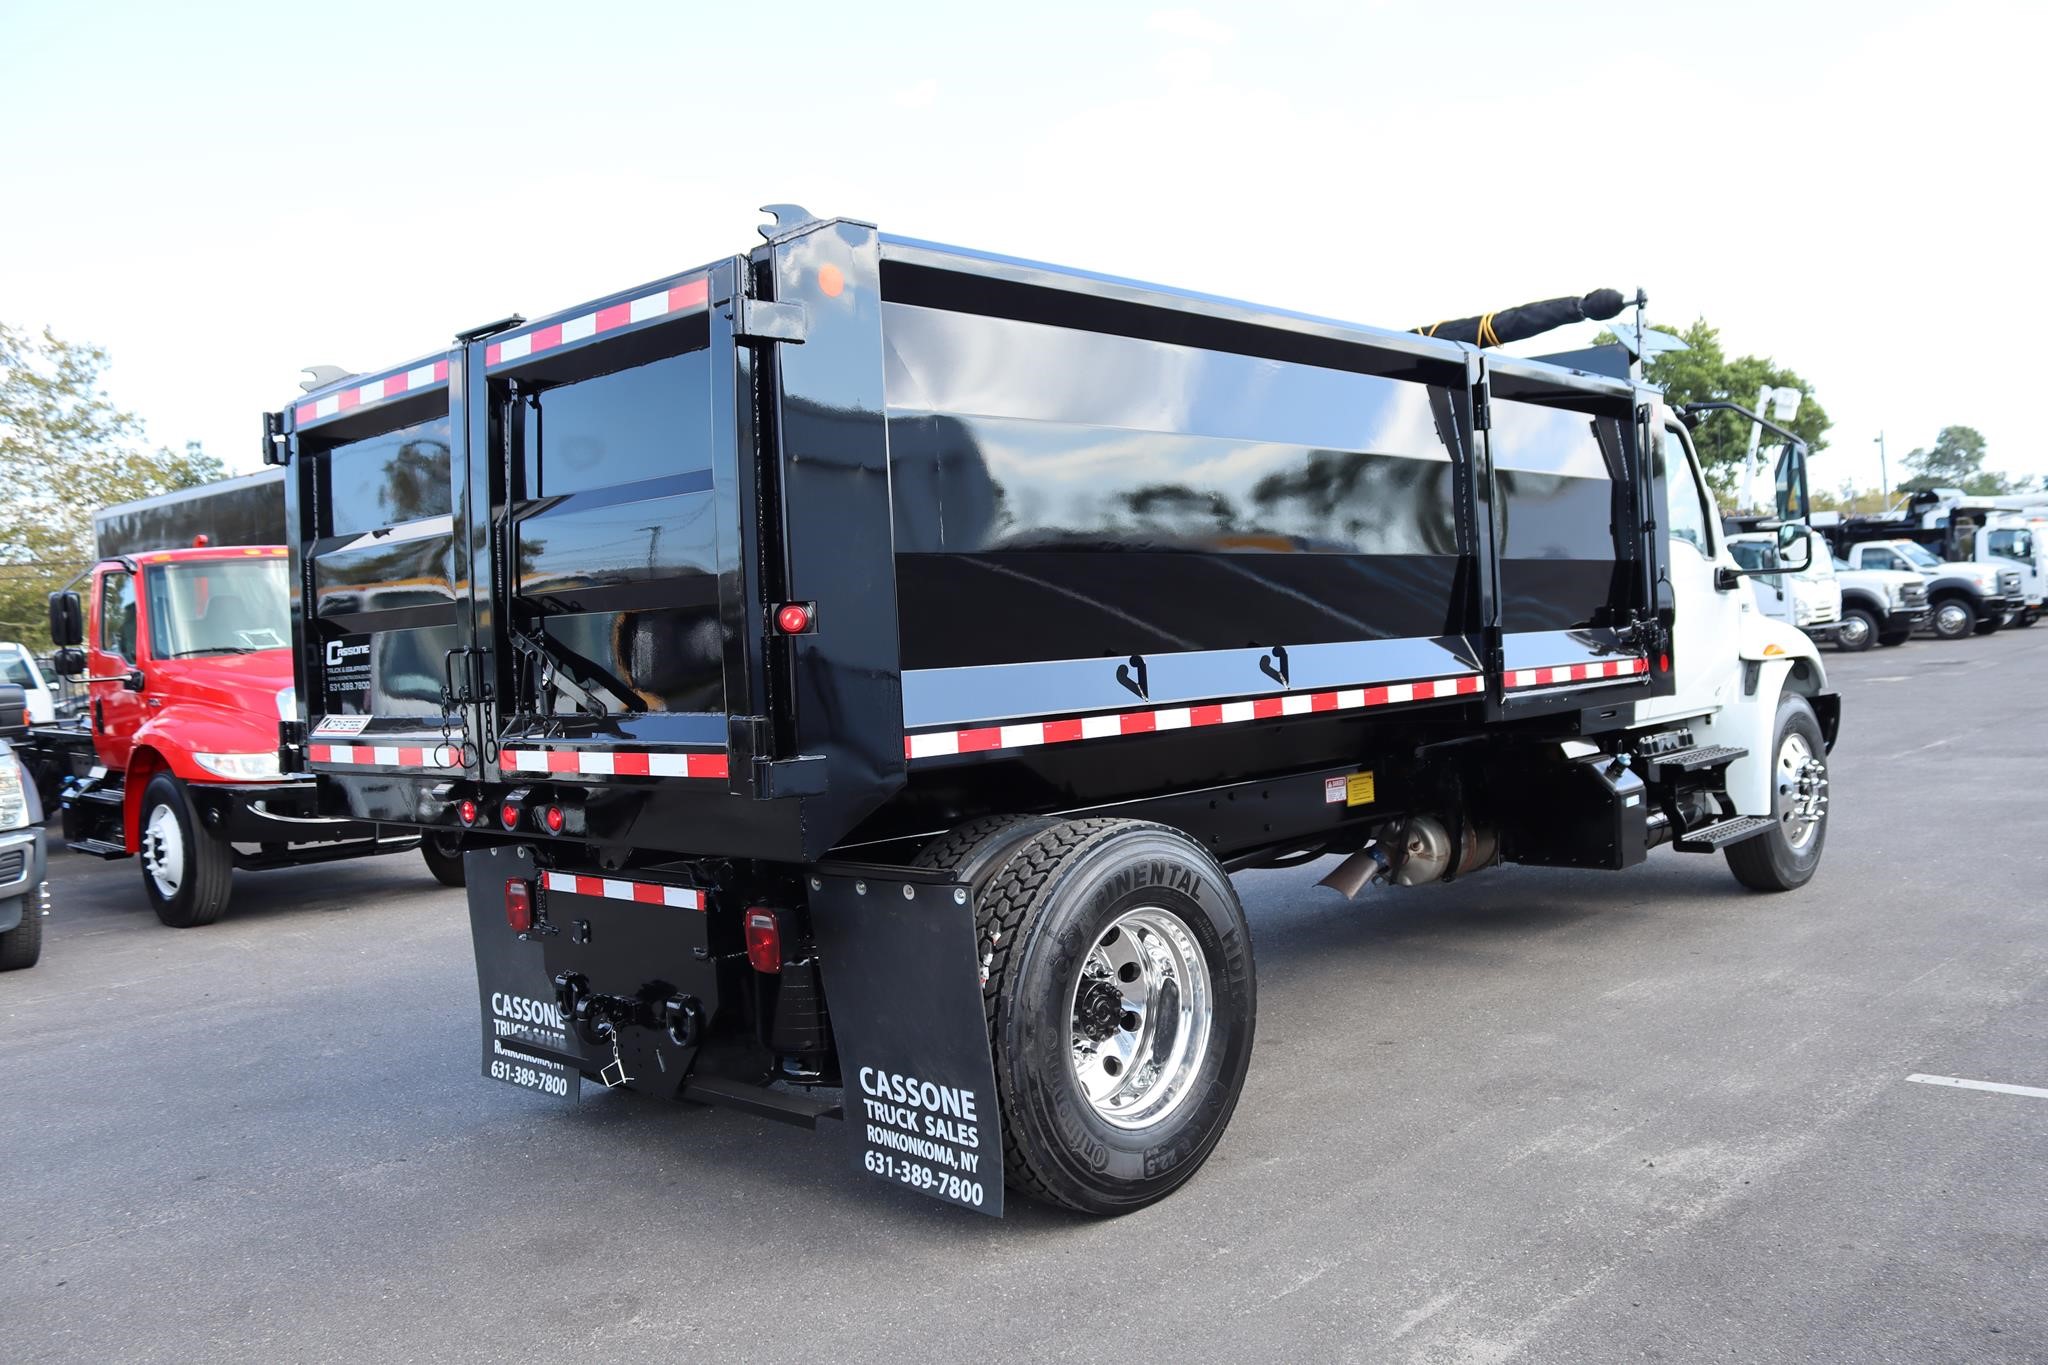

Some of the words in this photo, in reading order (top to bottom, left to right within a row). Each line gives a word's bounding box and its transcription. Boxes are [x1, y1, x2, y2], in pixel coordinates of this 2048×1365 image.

[492, 992, 566, 1030] CASSONE
[491, 1060, 567, 1096] 631-389-7800
[859, 1066, 978, 1122] CASSONE
[863, 1098, 920, 1132] TRUCK
[924, 1115, 979, 1148] SALES
[866, 1124, 959, 1171] RONKONKOMA,
[960, 1150, 979, 1173] NY
[864, 1150, 984, 1206] 631-389-7800
